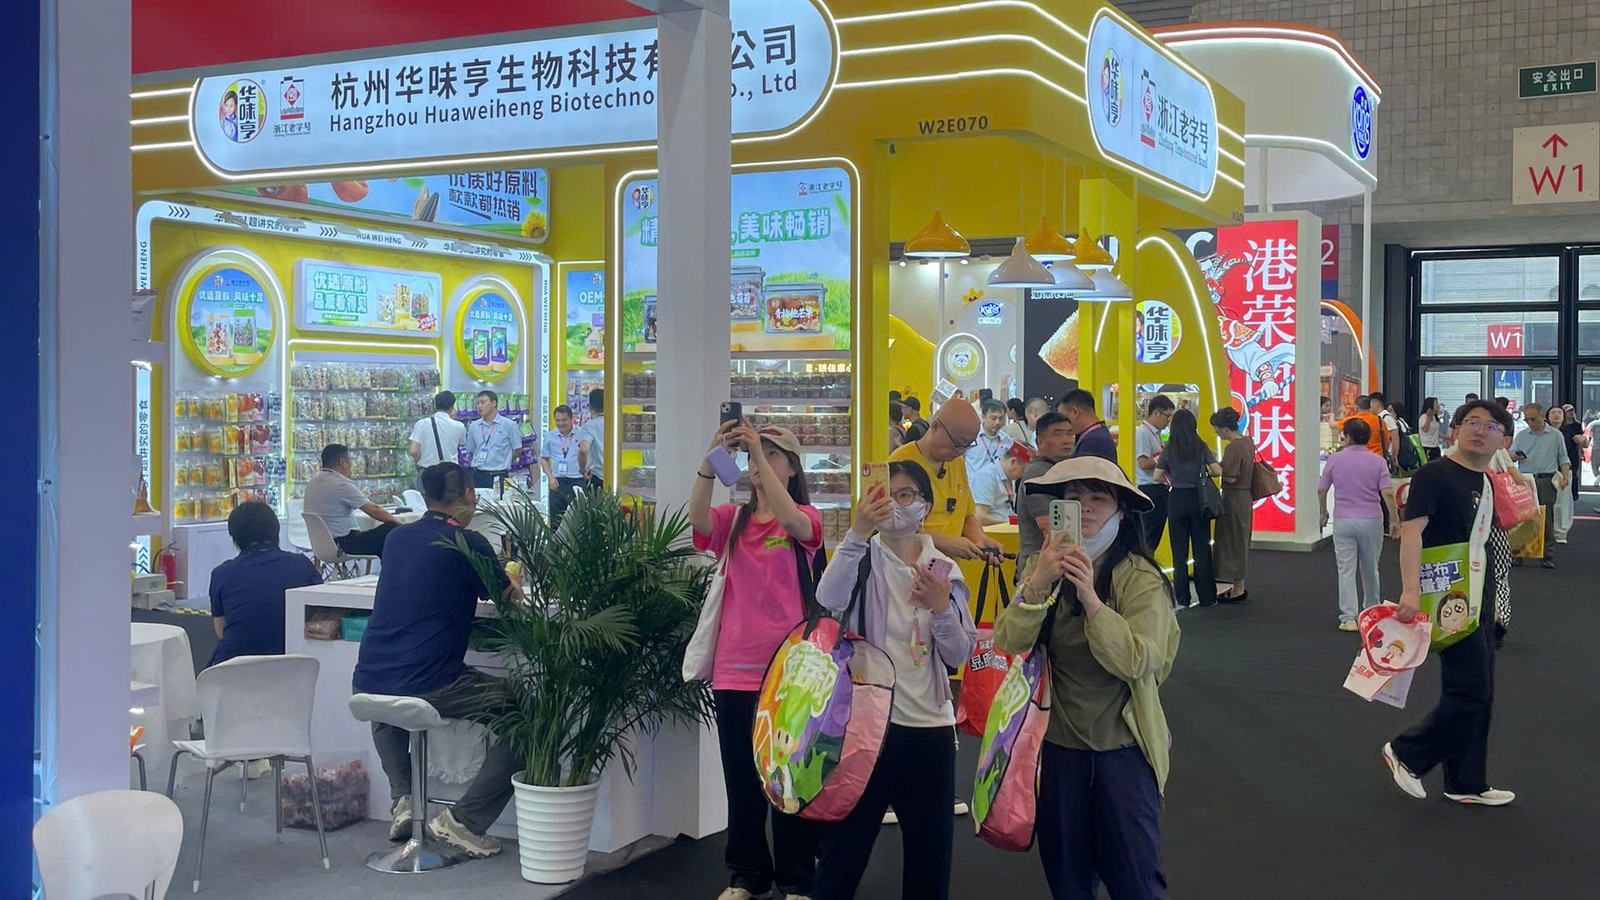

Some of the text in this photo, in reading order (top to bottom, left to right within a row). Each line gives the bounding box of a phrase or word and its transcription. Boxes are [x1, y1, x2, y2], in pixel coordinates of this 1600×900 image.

[1532, 68, 1584, 84] 安全出口
[1543, 82, 1572, 93] EXIT
[330, 103, 418, 134] Hangzhou
[425, 97, 543, 125] Huaweiheng
[551, 86, 655, 114] Biotechno
[762, 69, 797, 95] Ltd
[239, 84, 257, 140] 华味亨
[273, 121, 311, 134] 浙江老字号
[918, 115, 988, 135] W2E070
[1158, 94, 1208, 154] 浙江老字号
[1528, 164, 1583, 196] W1
[448, 188, 521, 222] 款款都热销
[372, 234, 383, 243] WEI
[384, 236, 402, 245] HENG
[140, 241, 148, 269] HENG
[579, 291, 604, 304] OEM
[1146, 306, 1167, 360] 华味亨
[1490, 331, 1521, 349] W1
[1433, 560, 1463, 576] 布丁
